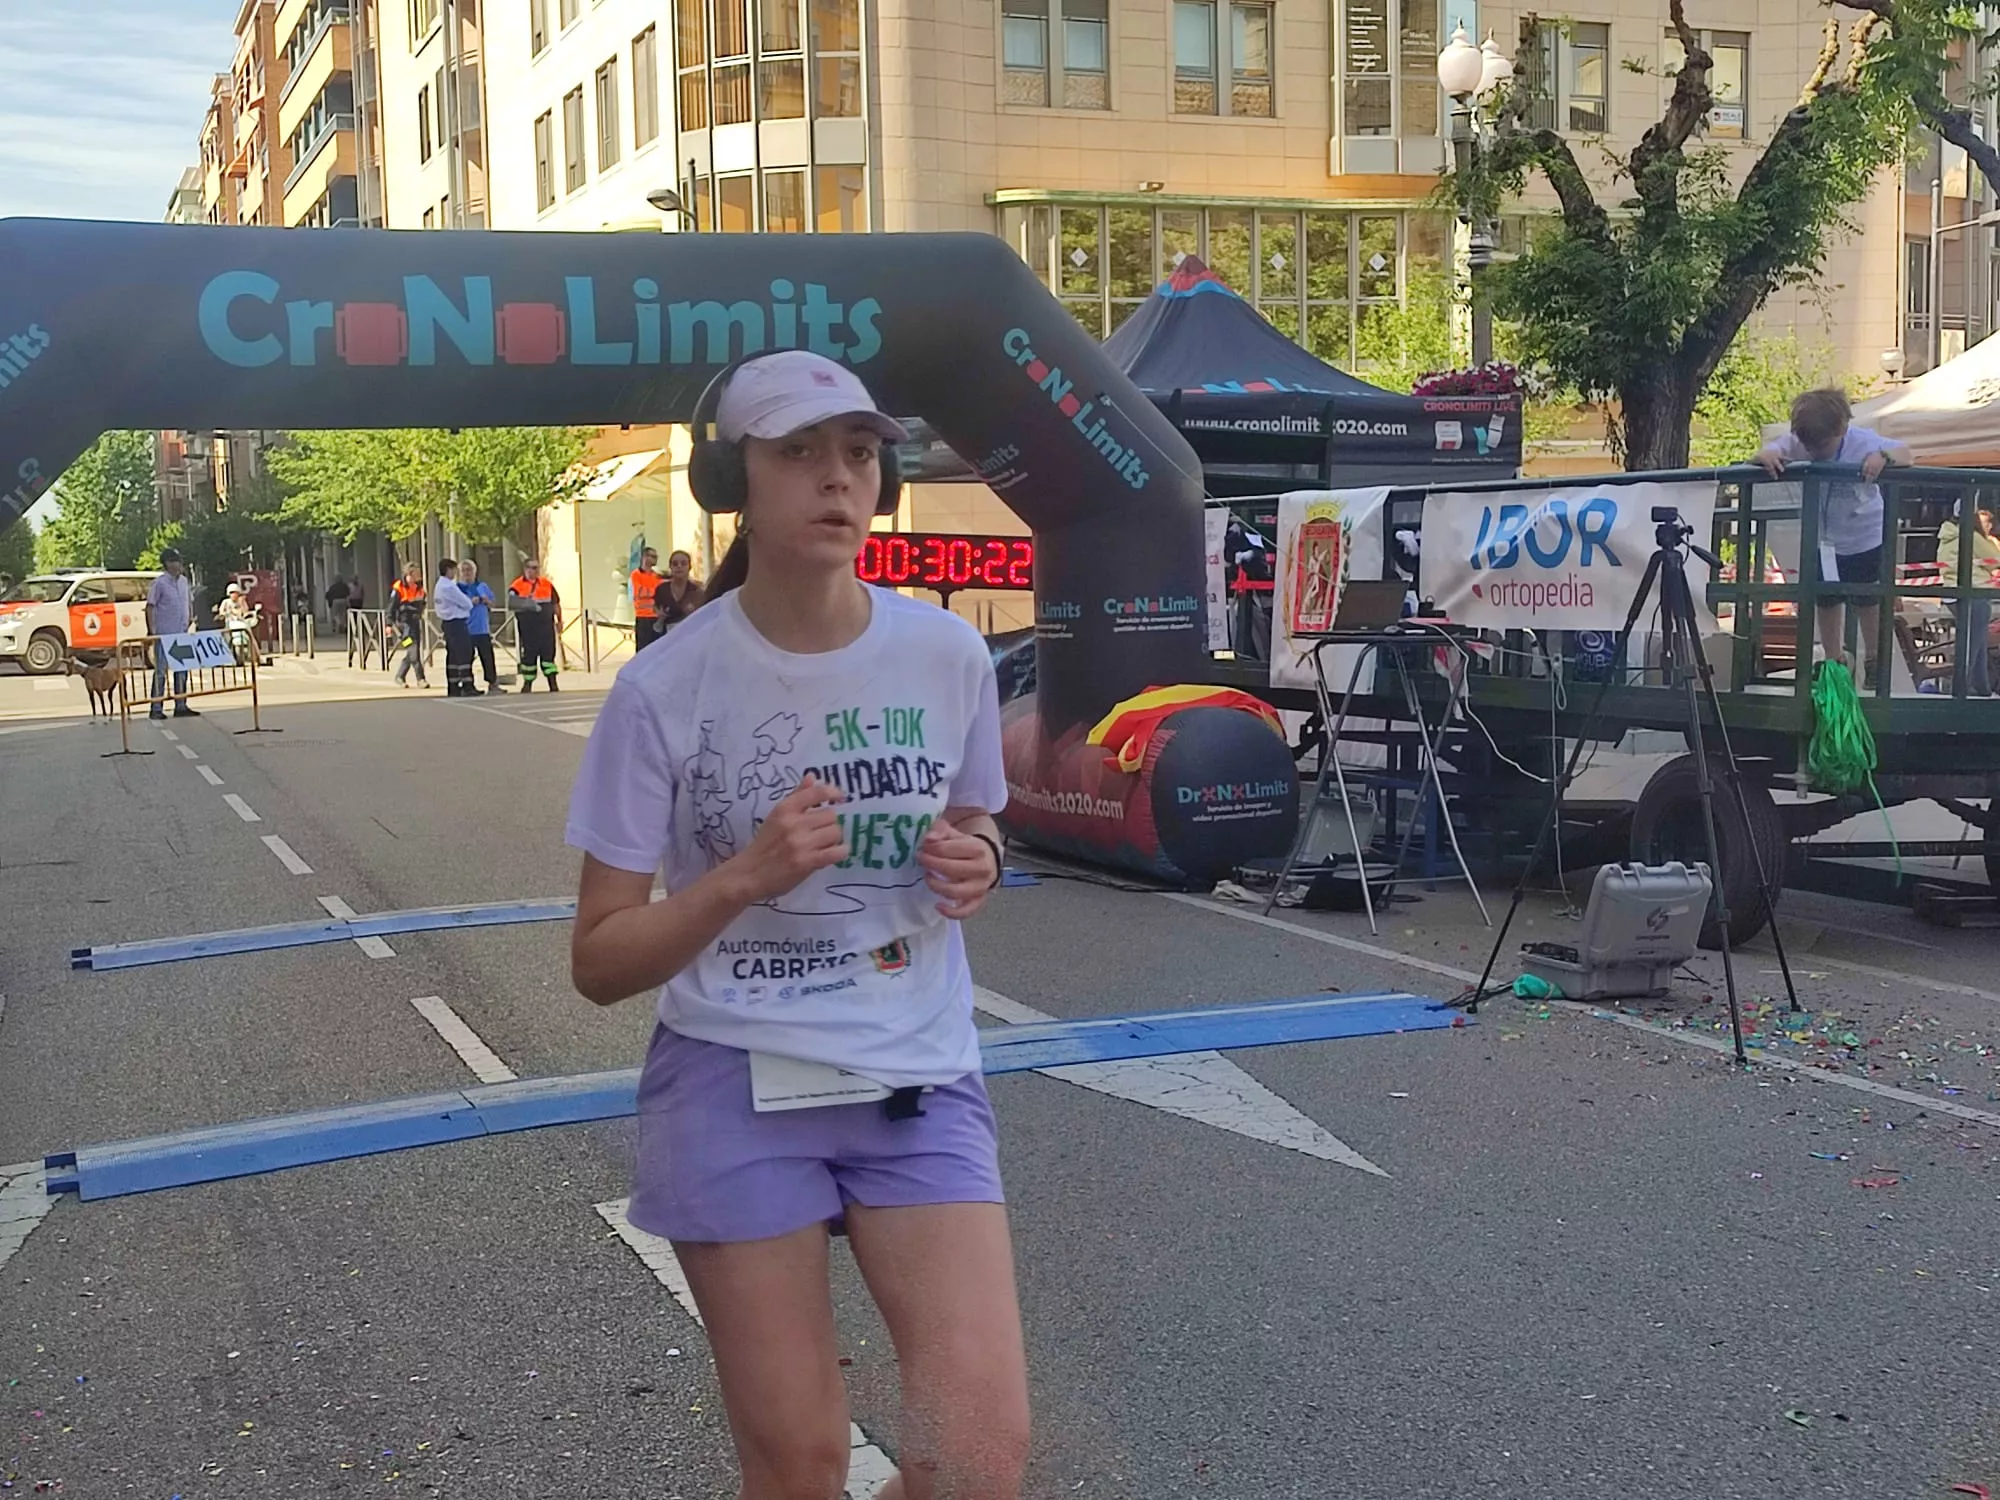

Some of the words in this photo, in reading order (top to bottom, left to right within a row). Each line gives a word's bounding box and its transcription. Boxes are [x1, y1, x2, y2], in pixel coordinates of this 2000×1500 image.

[1494, 401, 1517, 411] LIVE
[1470, 498, 1622, 570] IBOR
[857, 537, 1033, 585] 00:30:22
[1490, 573, 1594, 616] ortopedia
[825, 707, 926, 752] 5K-10K
[717, 937, 836, 957] Automóviles
